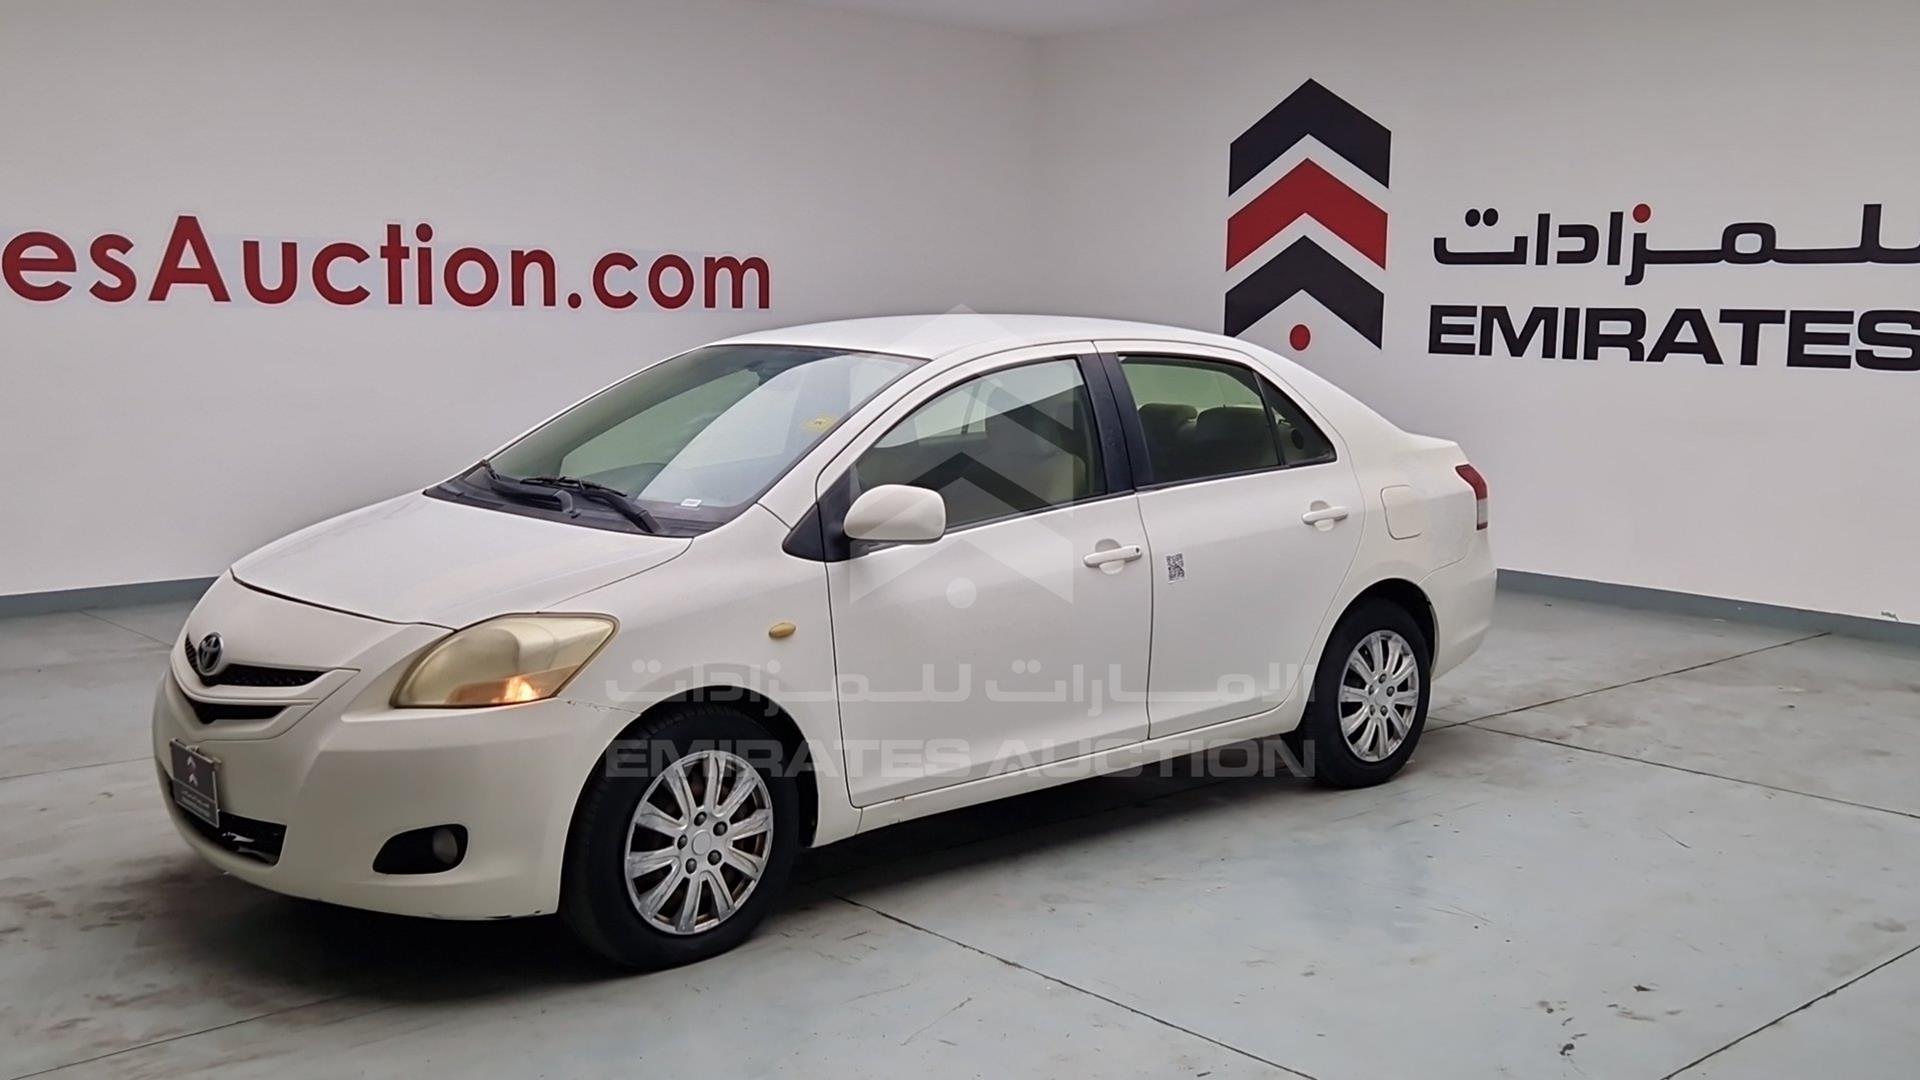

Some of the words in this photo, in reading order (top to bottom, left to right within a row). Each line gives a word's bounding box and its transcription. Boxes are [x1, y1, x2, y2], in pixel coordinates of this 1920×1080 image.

[2, 215, 770, 310] esAuction.com
[1434, 203, 1920, 286] لمزادات
[1429, 305, 1920, 371] EMIRATES
